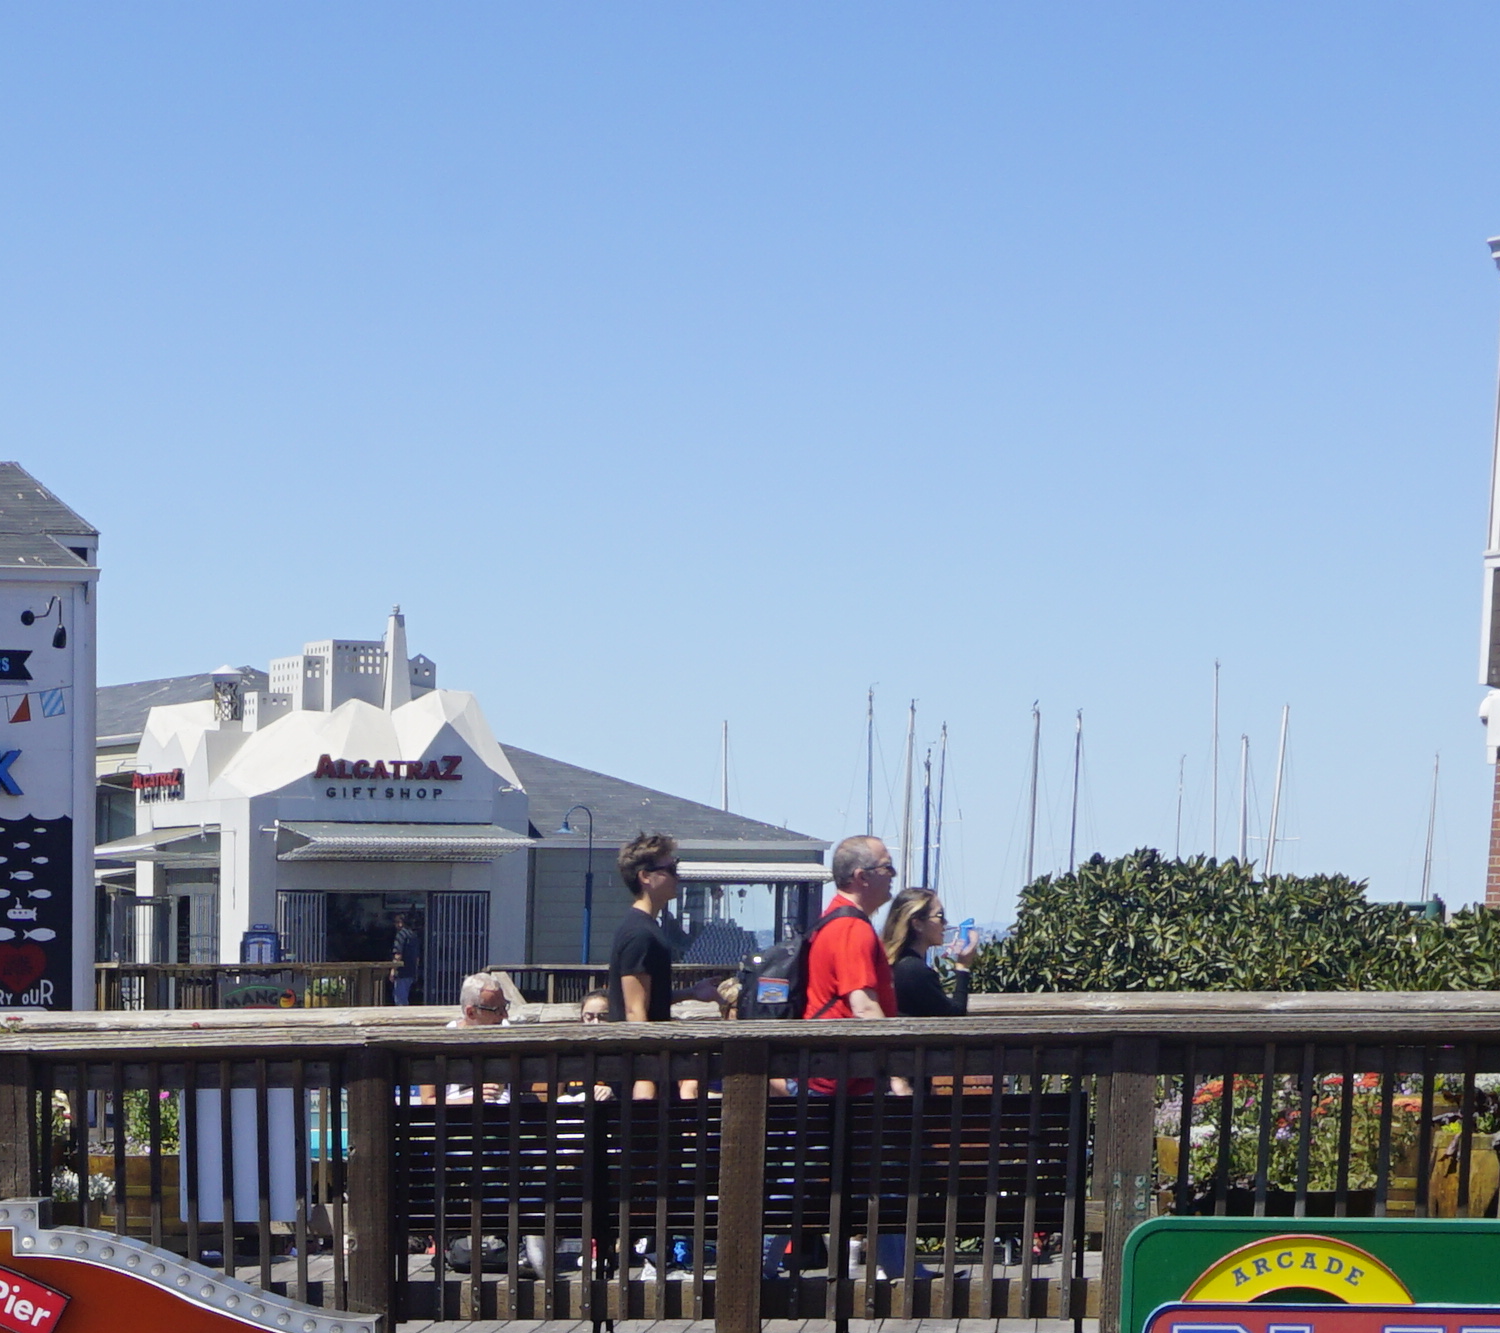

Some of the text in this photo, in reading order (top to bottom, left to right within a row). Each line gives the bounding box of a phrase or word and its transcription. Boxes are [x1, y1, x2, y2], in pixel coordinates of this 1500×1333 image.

[314, 754, 463, 781] ALCATRAZ
[326, 787, 444, 799] GIFT SHOP
[1231, 1251, 1365, 1287] ARCADE
